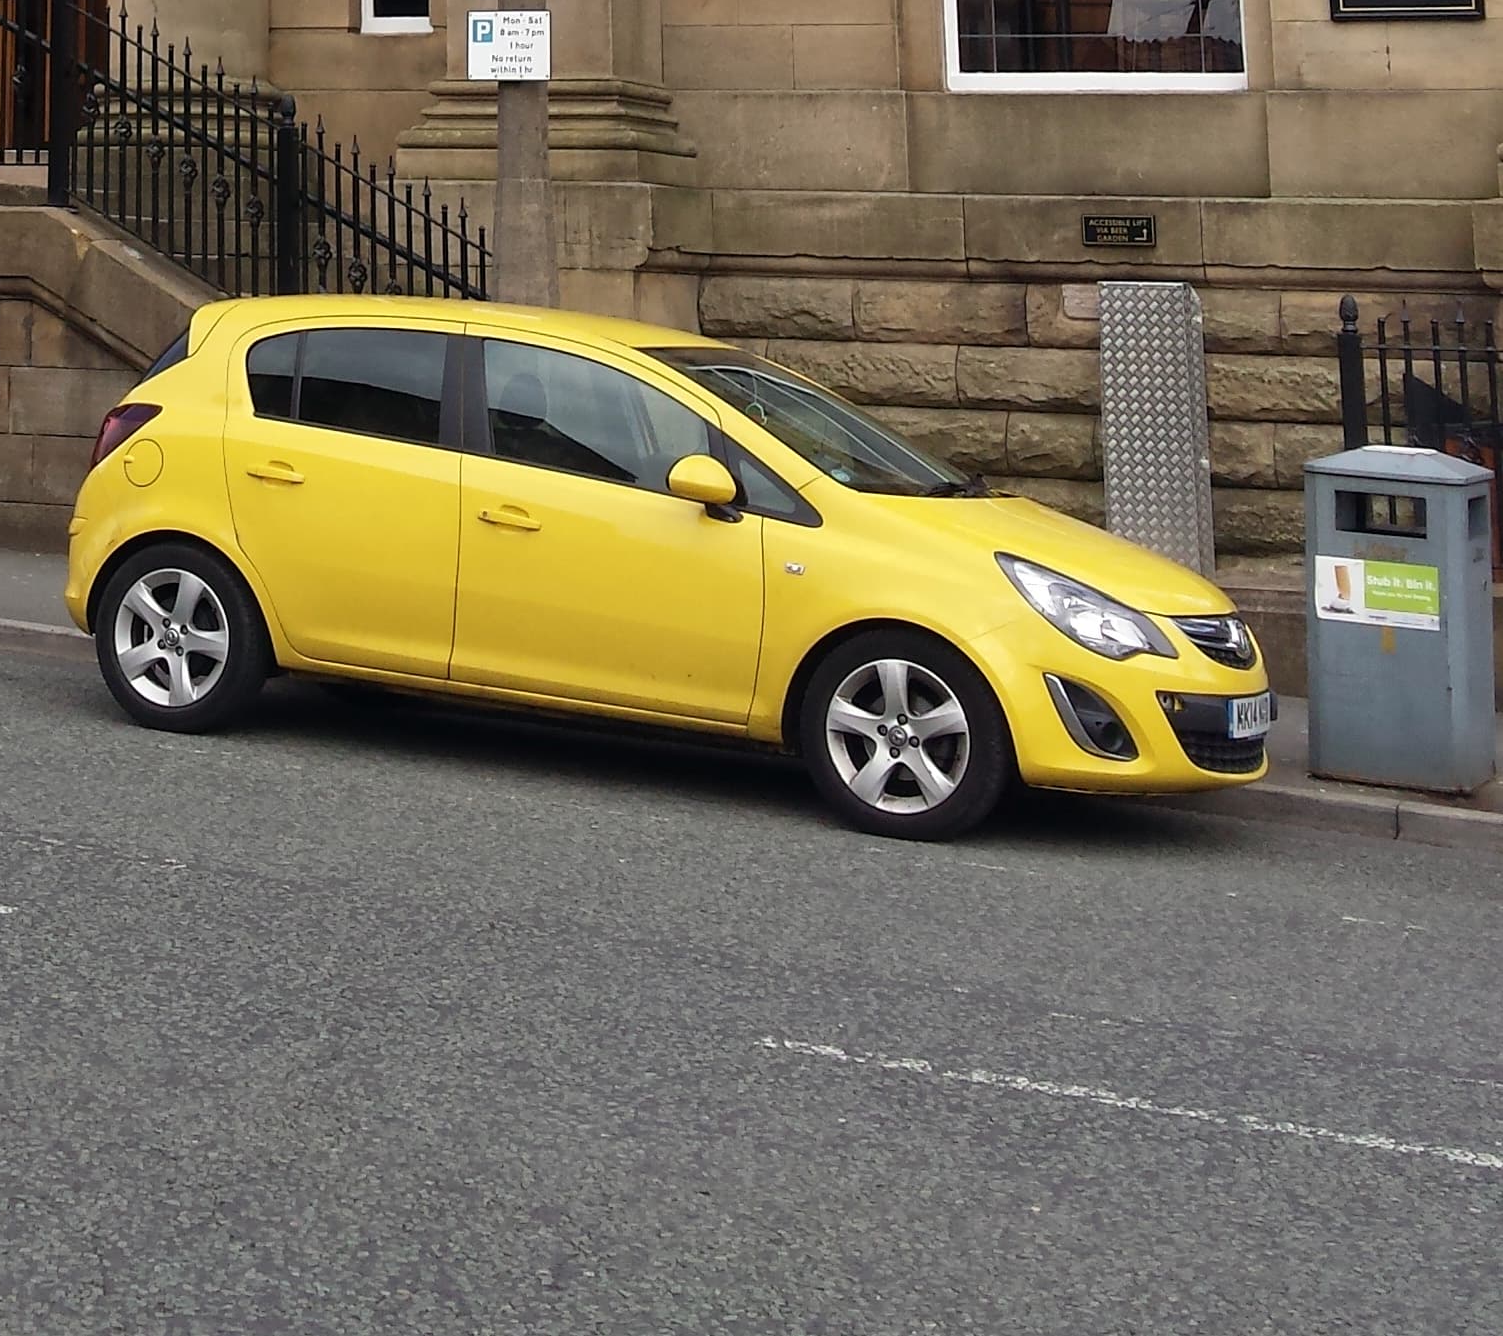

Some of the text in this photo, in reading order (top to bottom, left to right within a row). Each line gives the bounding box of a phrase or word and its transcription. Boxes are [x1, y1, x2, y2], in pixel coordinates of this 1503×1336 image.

[502, 16, 521, 25] Mon
[528, 16, 543, 25] Sat
[515, 41, 534, 50] hour
[491, 54, 532, 63] No return
[490, 65, 517, 74] within
